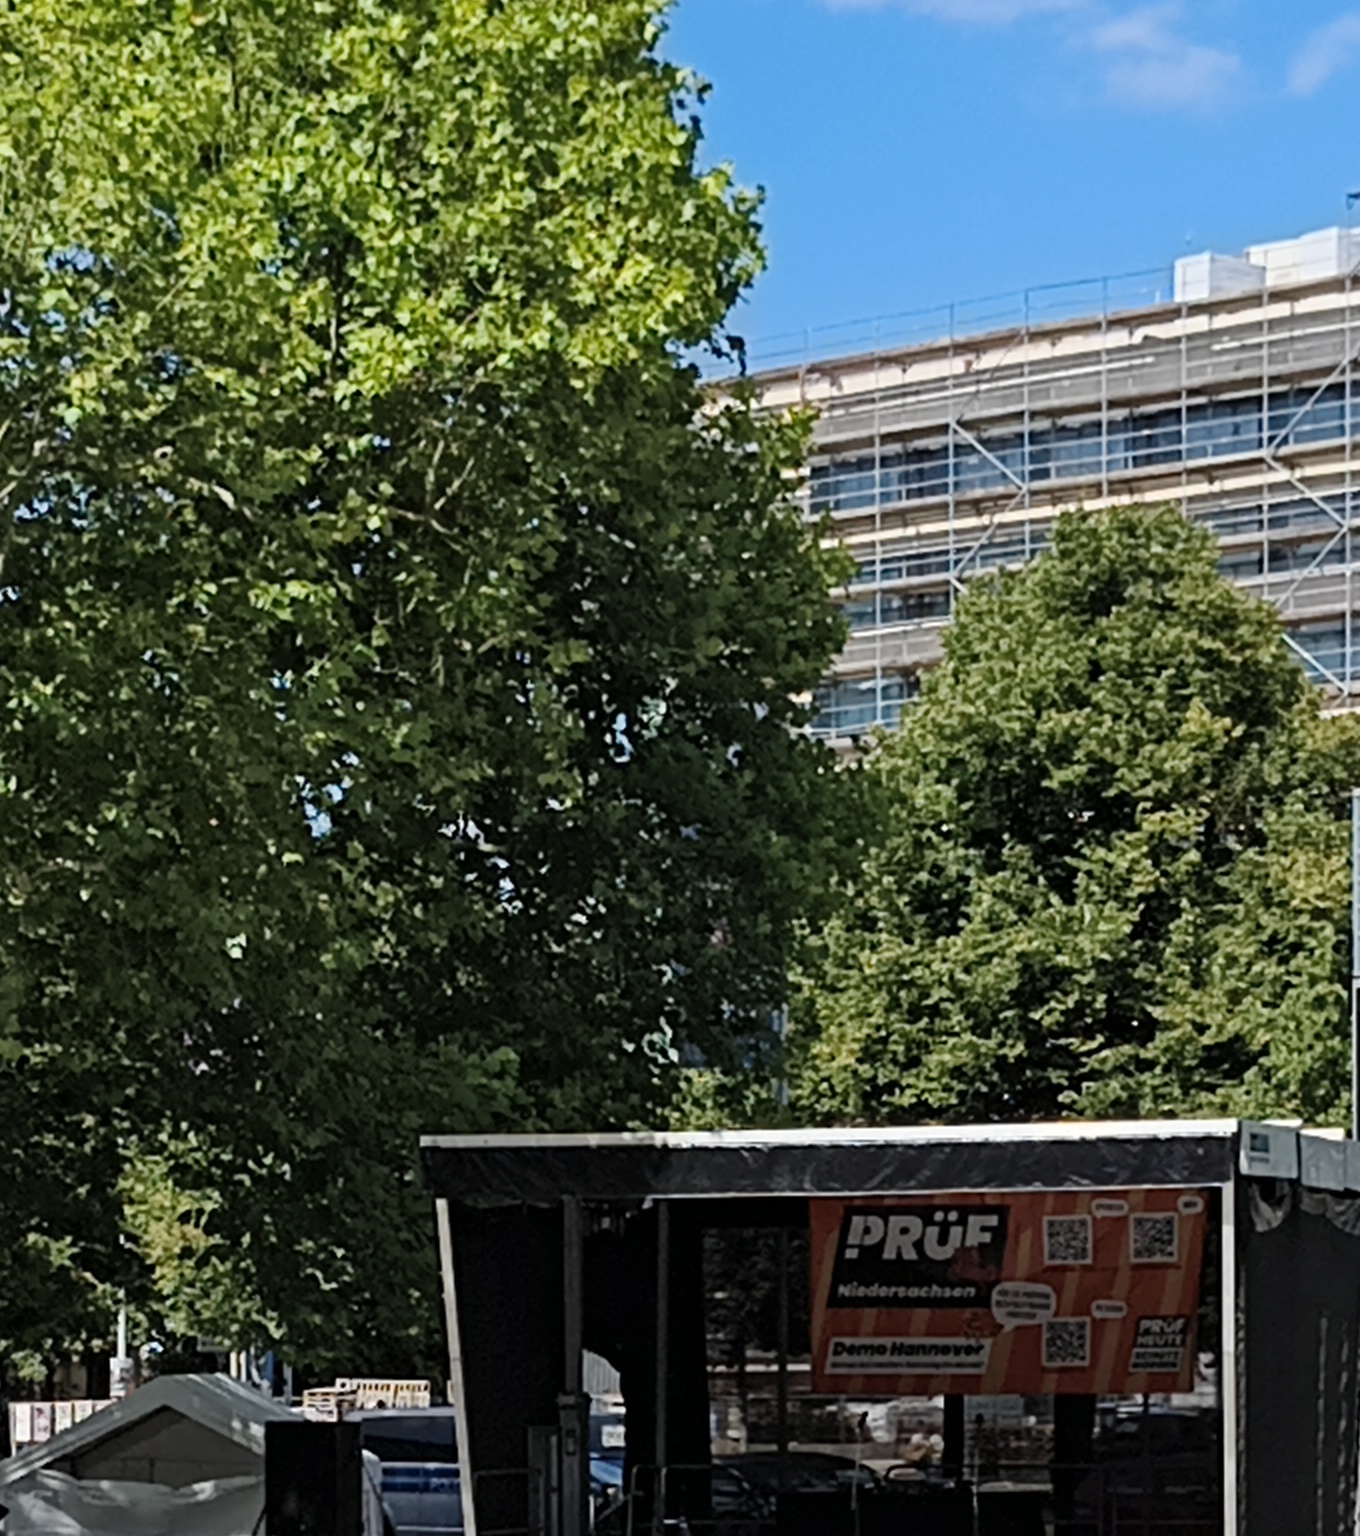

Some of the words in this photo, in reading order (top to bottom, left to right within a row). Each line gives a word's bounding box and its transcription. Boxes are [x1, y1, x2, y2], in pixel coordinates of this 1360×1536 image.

[836, 1281, 977, 1299] Niedersachsen
[832, 1341, 887, 1357] Demo
[890, 1341, 984, 1357] Hannover
